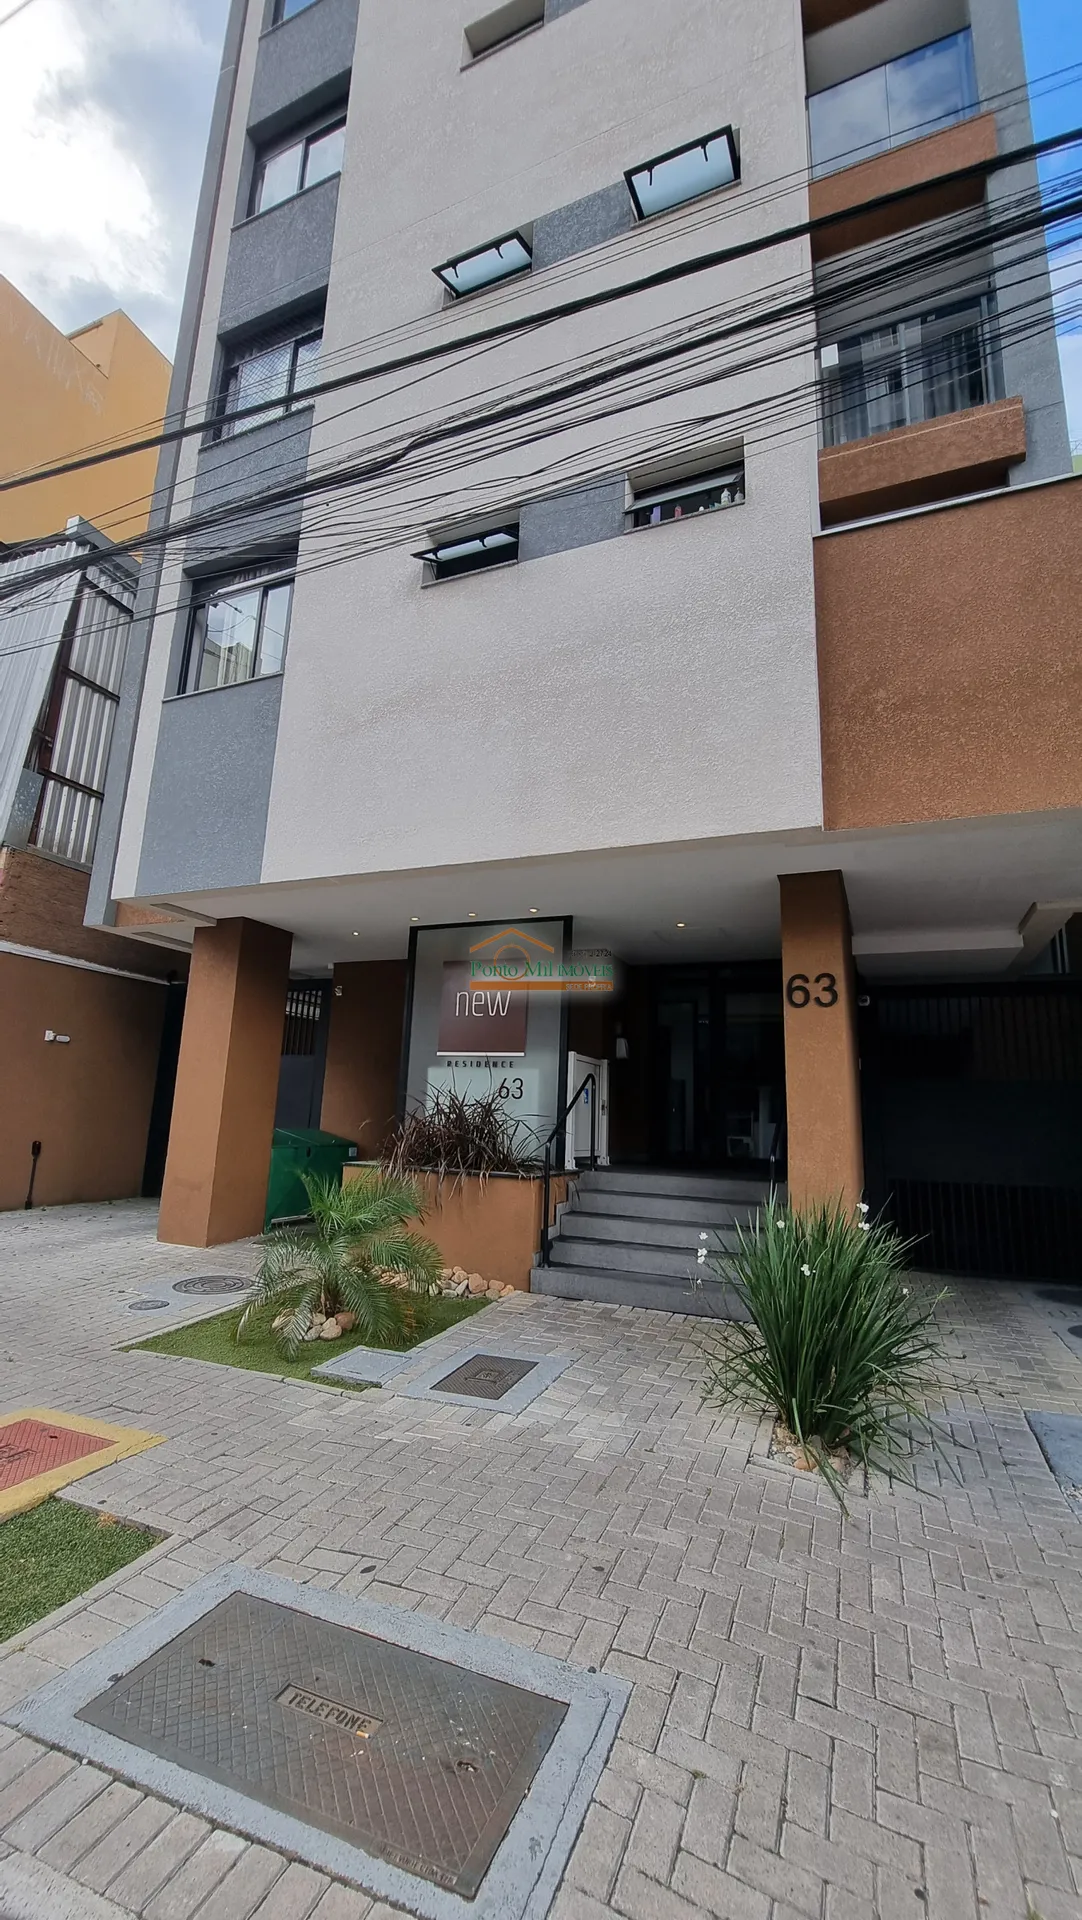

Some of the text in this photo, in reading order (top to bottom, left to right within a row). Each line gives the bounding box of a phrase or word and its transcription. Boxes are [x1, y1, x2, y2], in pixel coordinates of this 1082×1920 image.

[455, 990, 512, 1017] new
[786, 972, 839, 1009] 63
[446, 1060, 515, 1069] RESIDENCE
[498, 1077, 524, 1100] 63
[288, 1691, 372, 1734] TELEFONE
